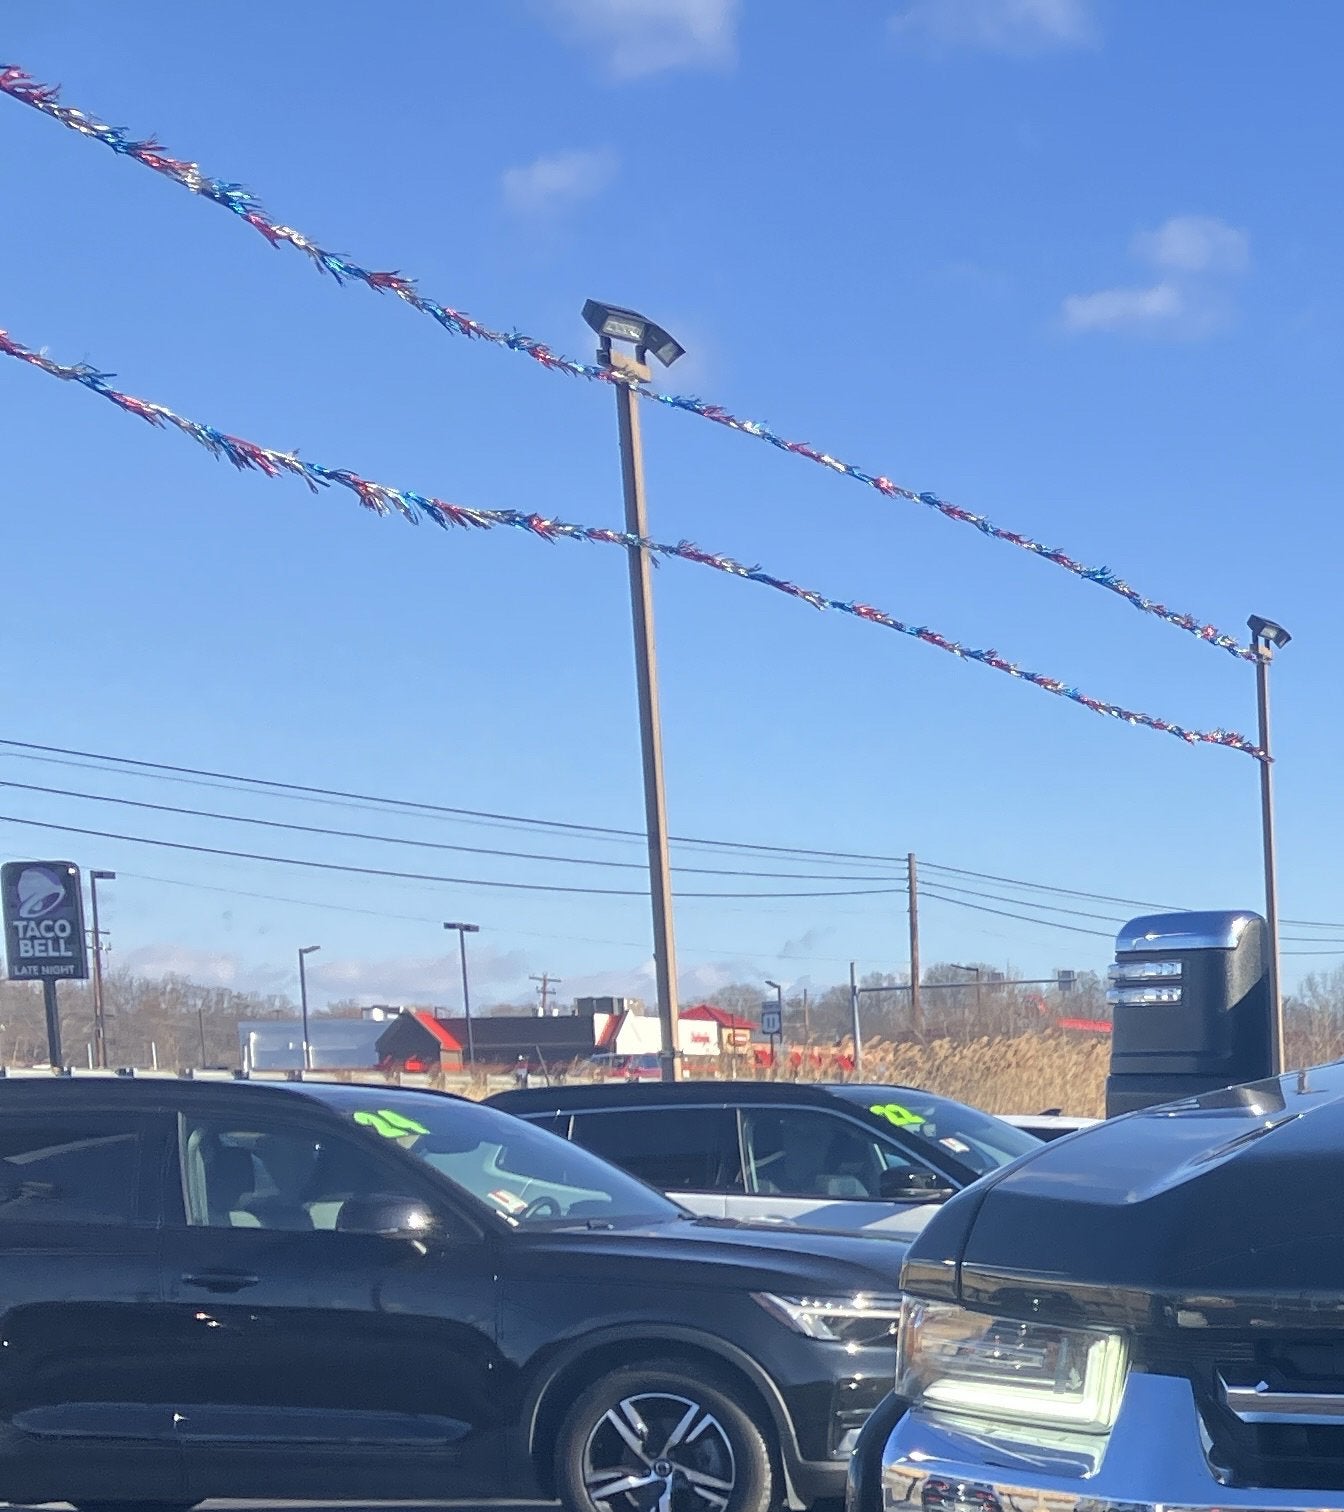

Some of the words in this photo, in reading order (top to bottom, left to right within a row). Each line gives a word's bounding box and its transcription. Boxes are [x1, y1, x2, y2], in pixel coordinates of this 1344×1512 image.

[12, 919, 71, 938] TACO
[19, 939, 73, 957] BELL
[14, 965, 39, 976] LATE
[41, 965, 74, 975] NIGHT
